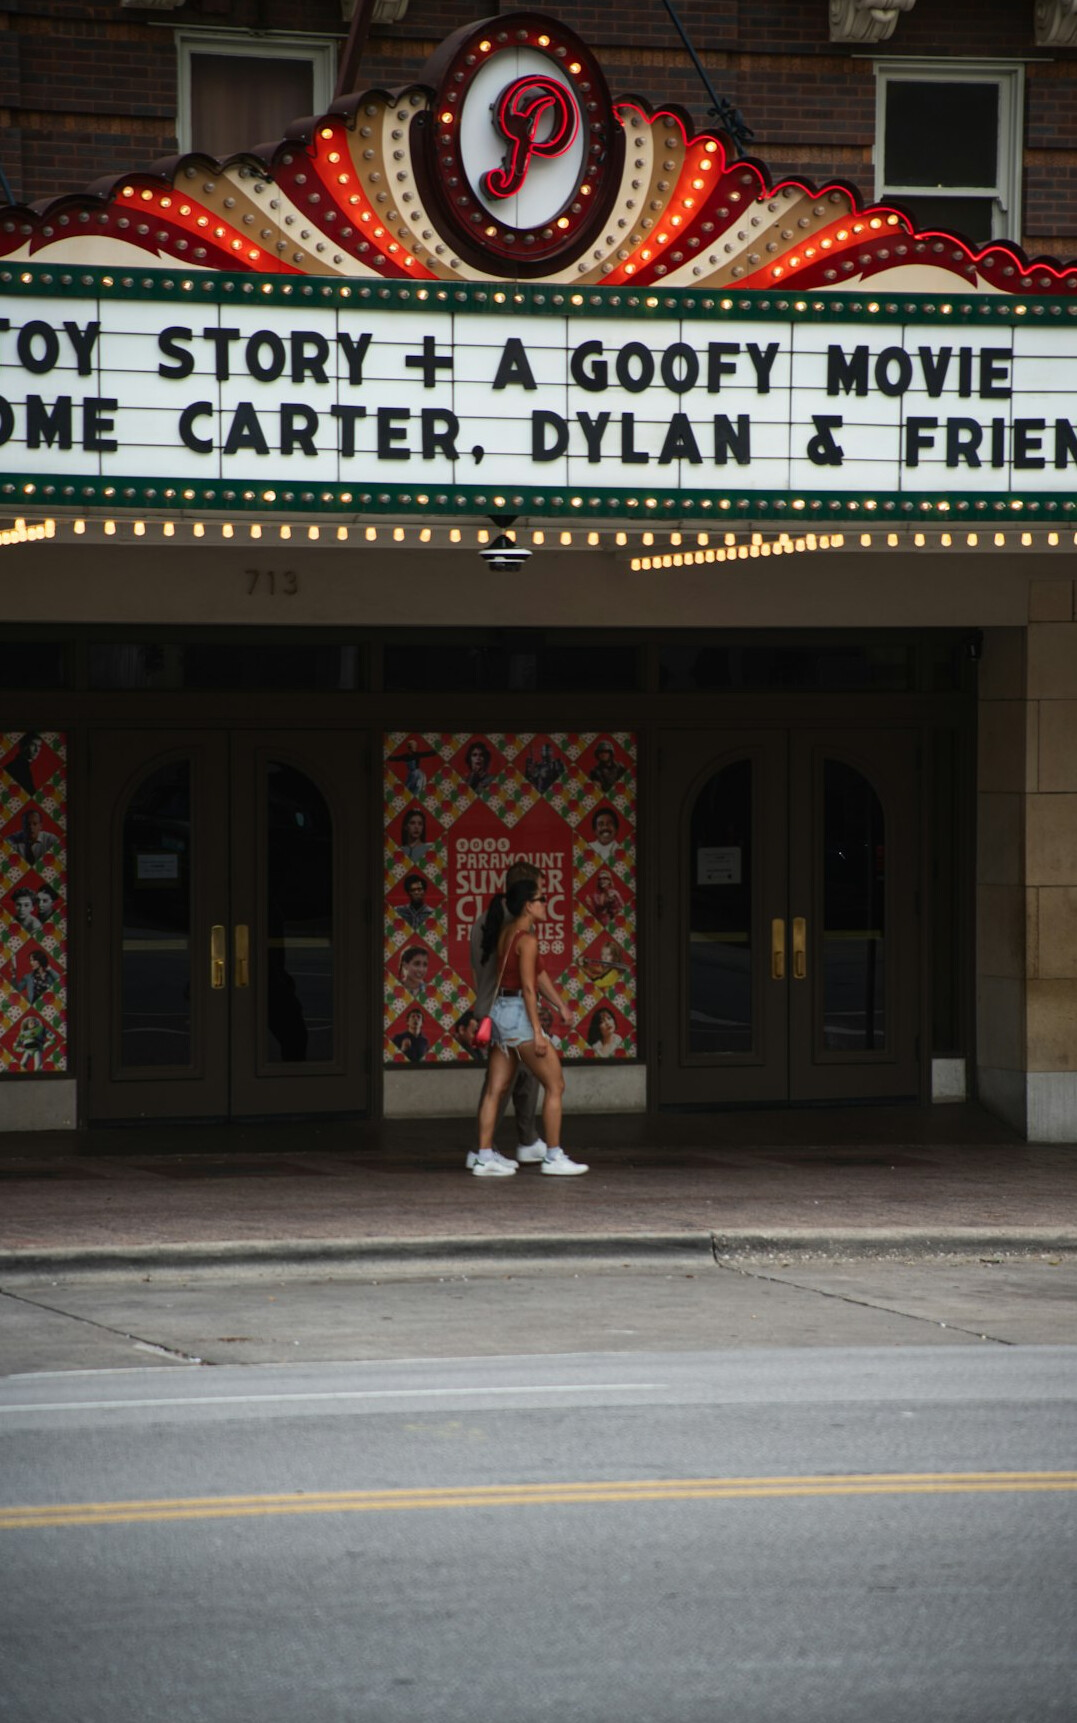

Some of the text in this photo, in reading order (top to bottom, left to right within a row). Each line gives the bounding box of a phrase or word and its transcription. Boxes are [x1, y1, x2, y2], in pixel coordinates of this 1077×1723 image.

[481, 74, 579, 200] P
[0, 318, 1015, 400] OY STORY + A GOOFY MOVIE
[179, 401, 485, 466] CARTER,
[532, 411, 751, 466] DYLAN
[806, 415, 845, 466] &
[906, 417, 1077, 470] FRIEN
[244, 569, 299, 596] 713
[456, 853, 564, 869] PARAMOUNT
